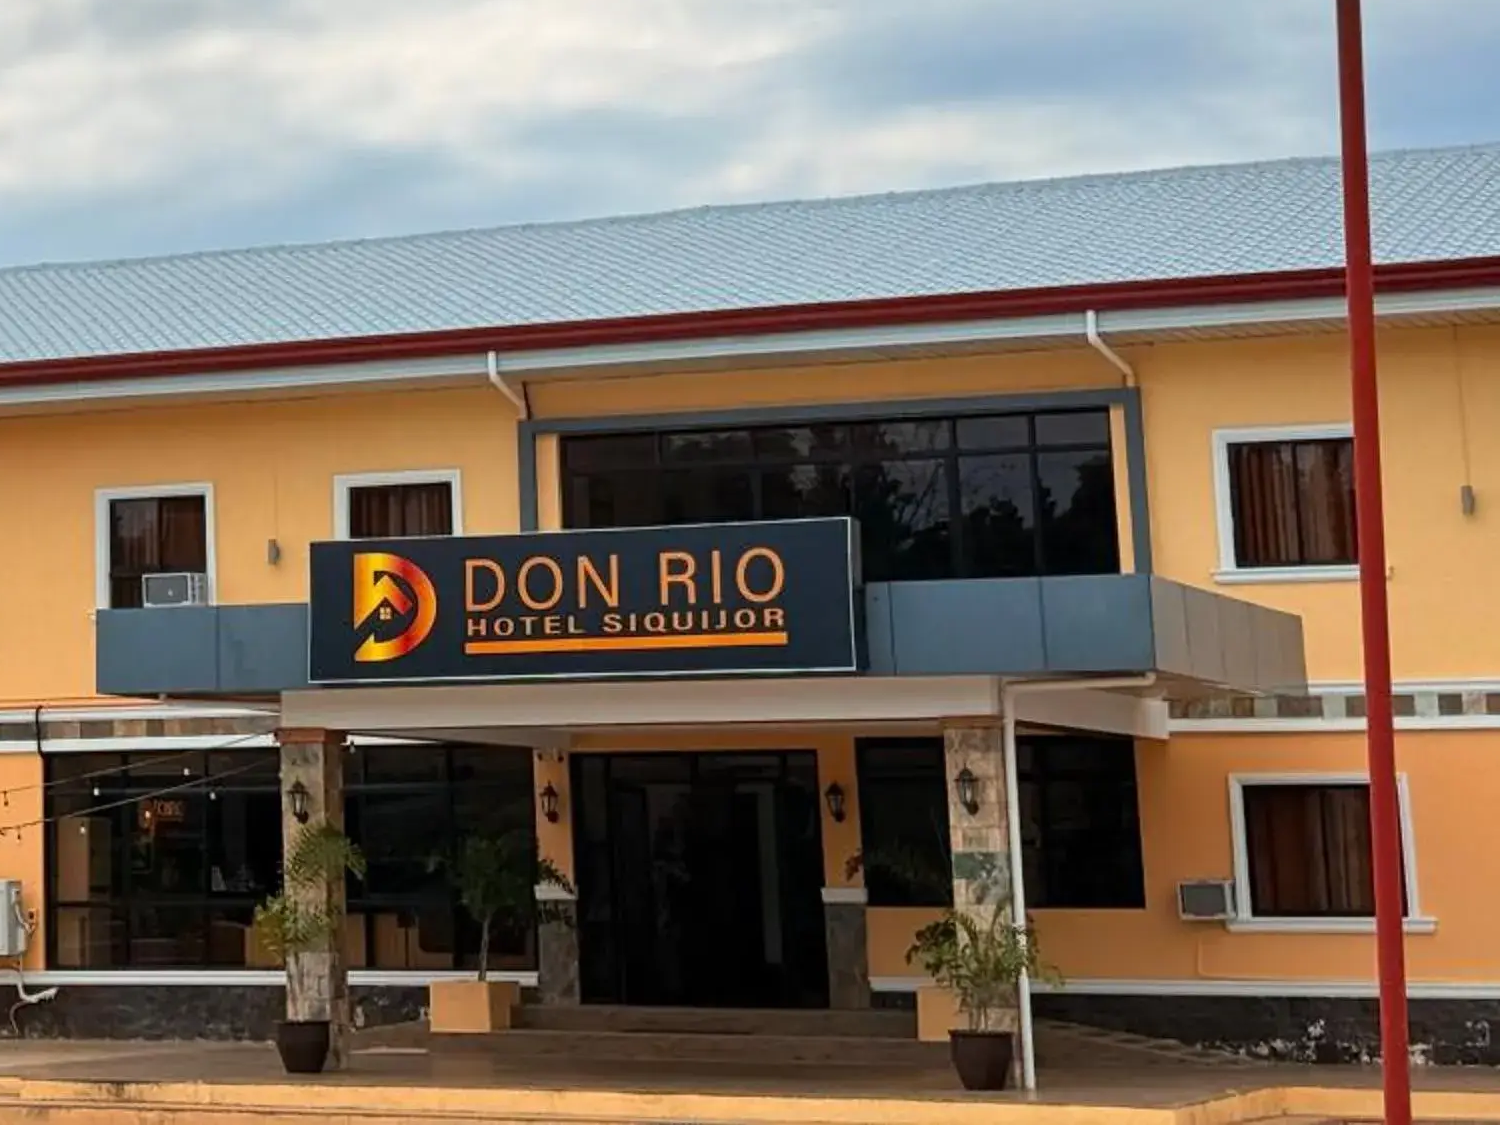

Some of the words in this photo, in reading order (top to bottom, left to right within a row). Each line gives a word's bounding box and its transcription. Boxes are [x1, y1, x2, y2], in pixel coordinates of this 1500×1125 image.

[464, 553, 619, 613] DON
[658, 546, 785, 606] RIO
[466, 615, 583, 637] HOTEL
[602, 607, 786, 634] SIQUIJOR
